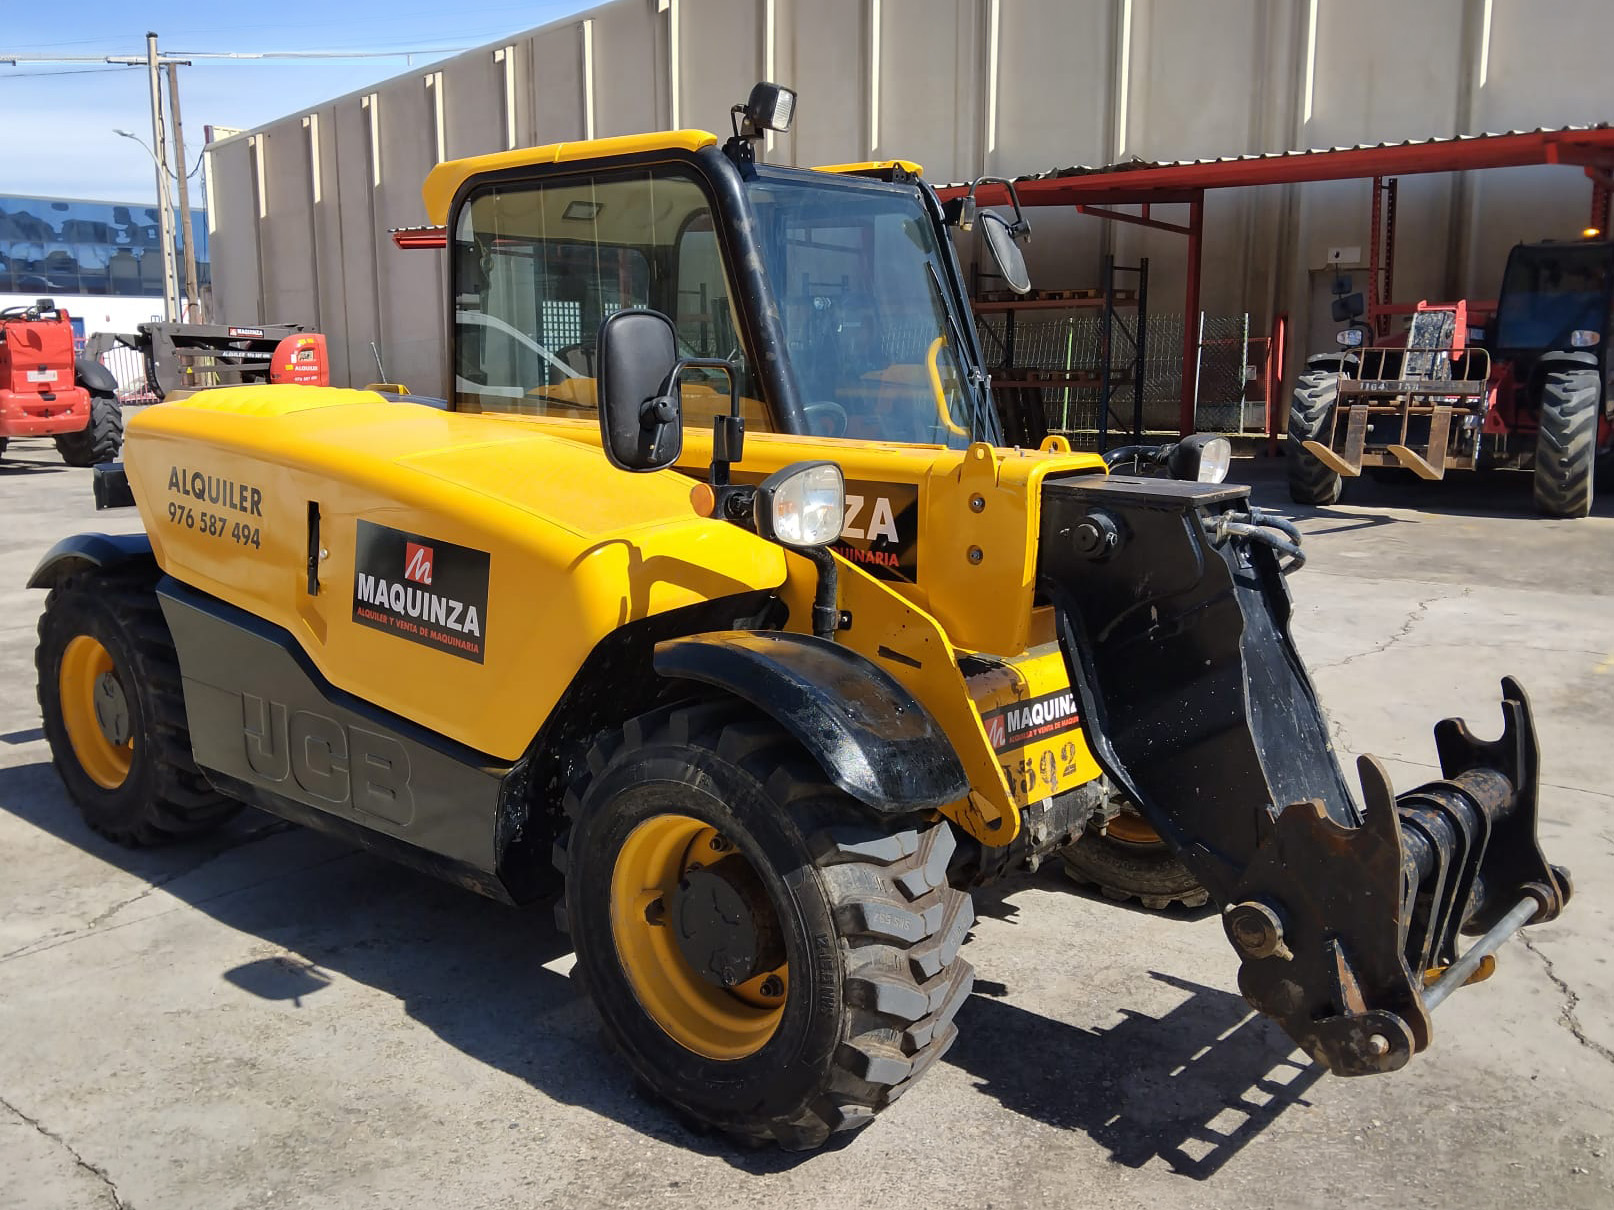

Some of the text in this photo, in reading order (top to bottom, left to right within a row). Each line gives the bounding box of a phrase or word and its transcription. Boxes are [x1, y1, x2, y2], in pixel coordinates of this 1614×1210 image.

[168, 466, 262, 517] ALQUILER
[168, 502, 261, 550] 976 587 494
[357, 573, 480, 637] MAQUINZA
[357, 608, 479, 653] ALQUILER Y VENTA DE MAQUINARIA
[241, 692, 415, 827] JCB
